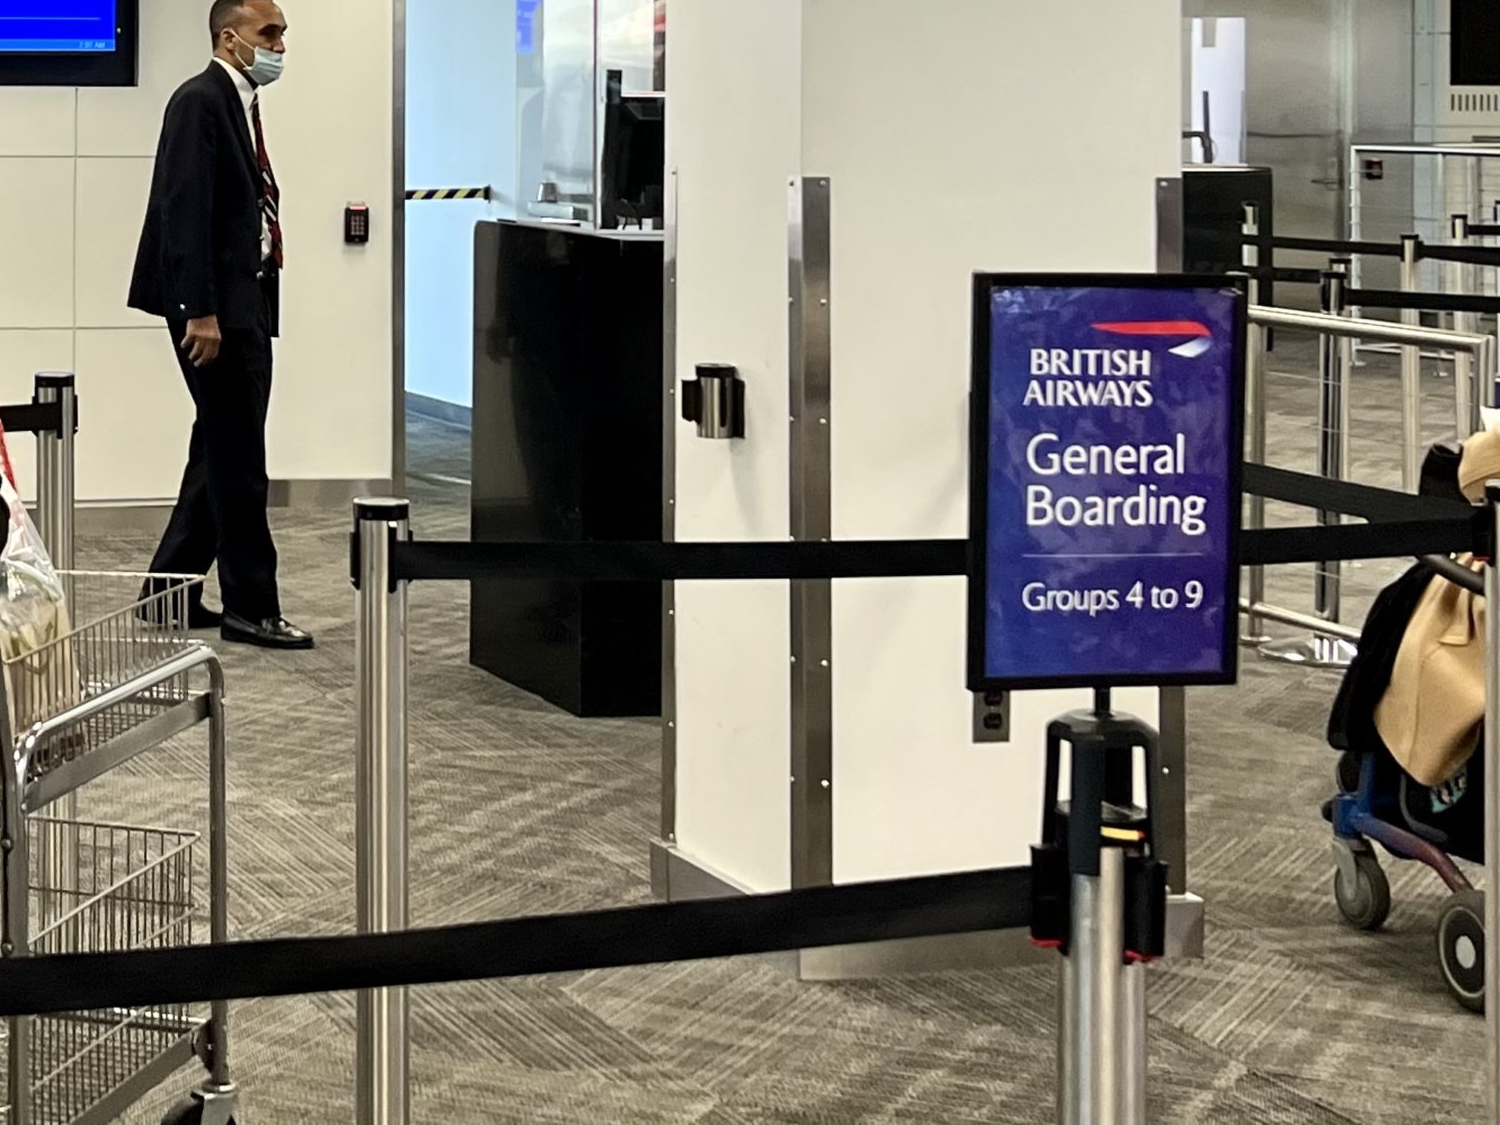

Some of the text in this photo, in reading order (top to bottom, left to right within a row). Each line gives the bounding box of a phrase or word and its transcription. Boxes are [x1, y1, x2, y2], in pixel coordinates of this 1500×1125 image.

[1029, 348, 1152, 376] BRITISH
[1022, 379, 1154, 407] AIRWAYS
[1025, 433, 1186, 476] General
[1025, 483, 1207, 536] Boarding
[1021, 580, 1204, 617] Groups 4 to 9
